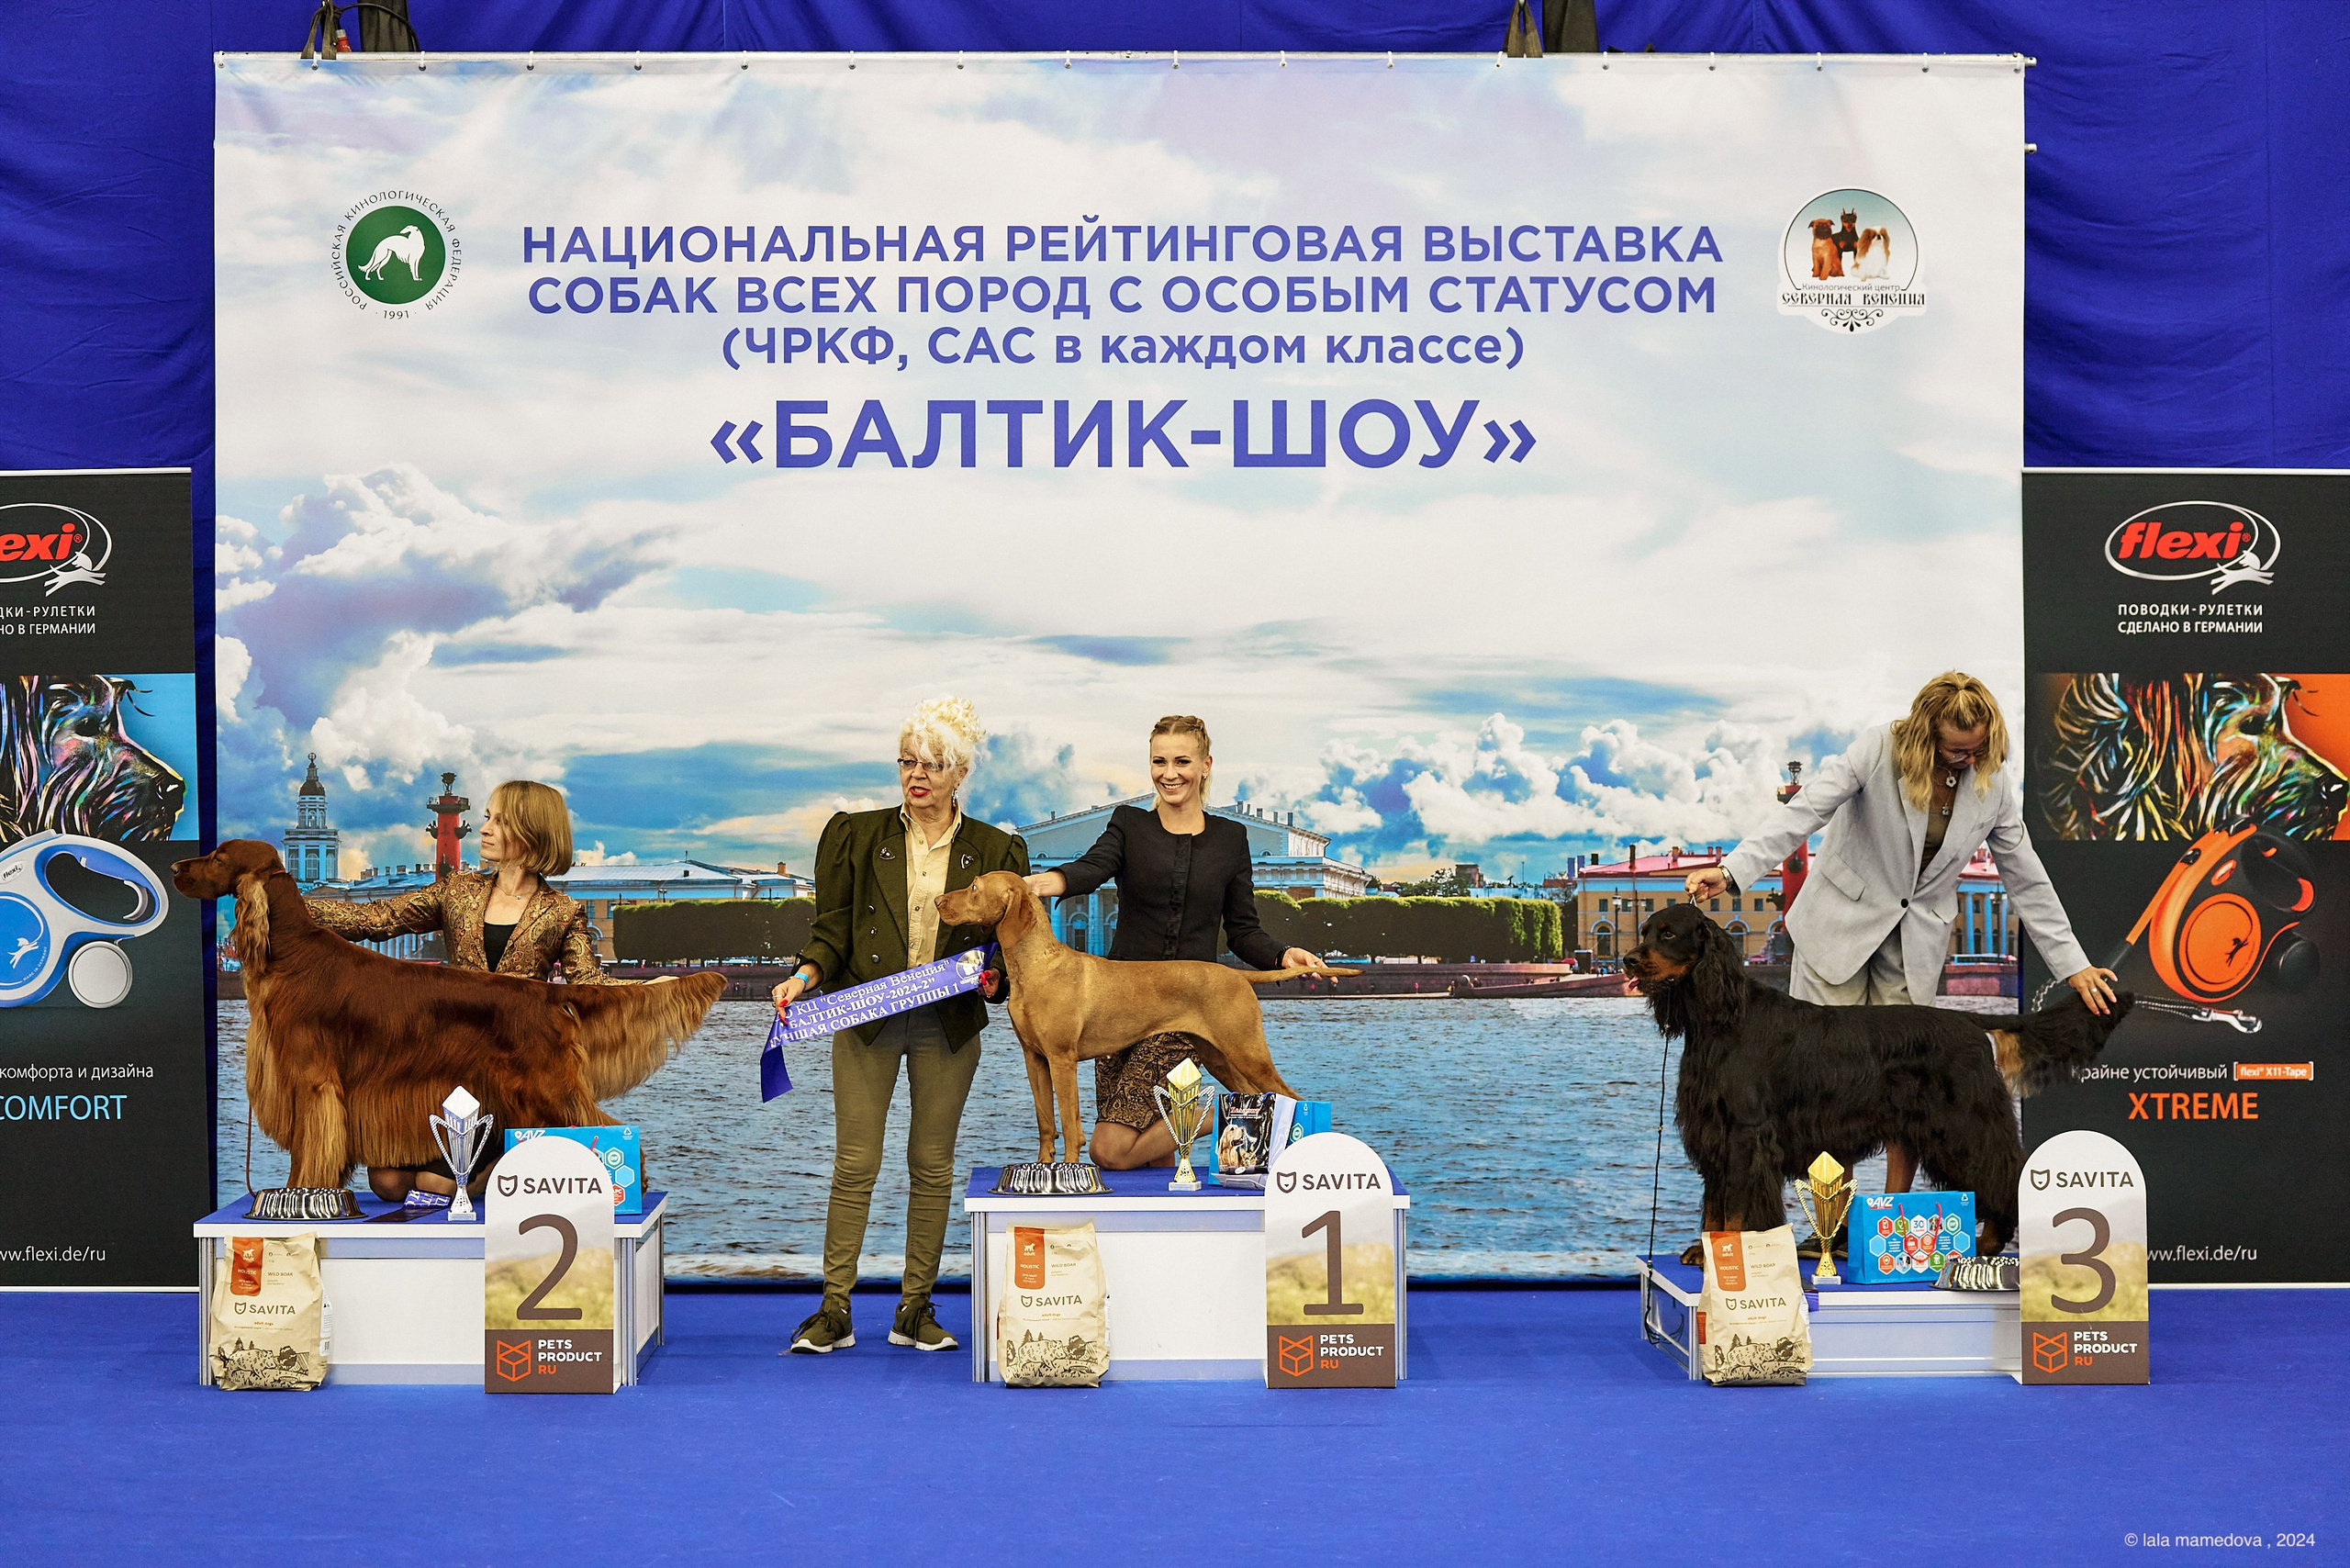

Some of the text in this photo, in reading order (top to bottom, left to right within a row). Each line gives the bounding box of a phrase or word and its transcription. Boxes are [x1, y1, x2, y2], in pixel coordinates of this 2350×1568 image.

[330, 190, 462, 311] РОССИЙСКАЯ КИНОЛОГИЧЕСКАЯ ФЕДЕРАЦИЯ
[523, 217, 1722, 270] НАЦИОНАЛЬНАЯ РЕЙТИНГОВАЯ ВЫСТАВКА
[1802, 283, 1900, 293] Кинологический центр
[529, 276, 1715, 319] СОБАК ВСЕХ ПОРОД С ОСОБЫМ СТАТУСОМ
[722, 327, 908, 371] (ЧРКФ,
[1056, 336, 1081, 364] в
[1102, 336, 1305, 370] каждом
[1326, 329, 1524, 371] классе)
[711, 399, 1537, 469] «БАЛТИК-ШОУ»
[2118, 603, 2263, 616] ПОВОДКИ-РУЛЕТКИ
[18, 623, 26, 635] В
[29, 622, 95, 634] ГЕРМАНИИ
[2118, 621, 2263, 634] СДЕЛАНО В ГЕРМАНИИ
[830, 1004, 889, 1031] СОБАКА
[890, 985, 951, 1013] ГРУППЫ
[0, 1063, 154, 1081] комфорта и дизайна
[2133, 1064, 2228, 1083] устойчивый
[0, 1094, 128, 1120] OMFORT
[2128, 1092, 2259, 1120] XTREME
[523, 1177, 603, 1194] SAVITA
[1303, 1172, 1382, 1191] SAVITA
[2055, 1171, 2134, 1188] SAVITA
[516, 1213, 583, 1320] 2
[1302, 1210, 1364, 1316] 1
[2051, 1206, 2117, 1315] 3
[1035, 1294, 1082, 1307] SAVITA
[1740, 1296, 1787, 1309] SAVITA
[249, 1304, 296, 1315] SAVITA
[1320, 1334, 1354, 1344] PETS
[2074, 1331, 2109, 1341] PETS
[539, 1338, 573, 1350] PETS
[1320, 1346, 1384, 1357] PRODUCT
[2074, 1343, 2138, 1353] PRODUCT
[538, 1351, 603, 1362] PRODUCT
[1320, 1359, 1339, 1369] RU
[2074, 1356, 2093, 1366] RU
[538, 1364, 557, 1374] RU
